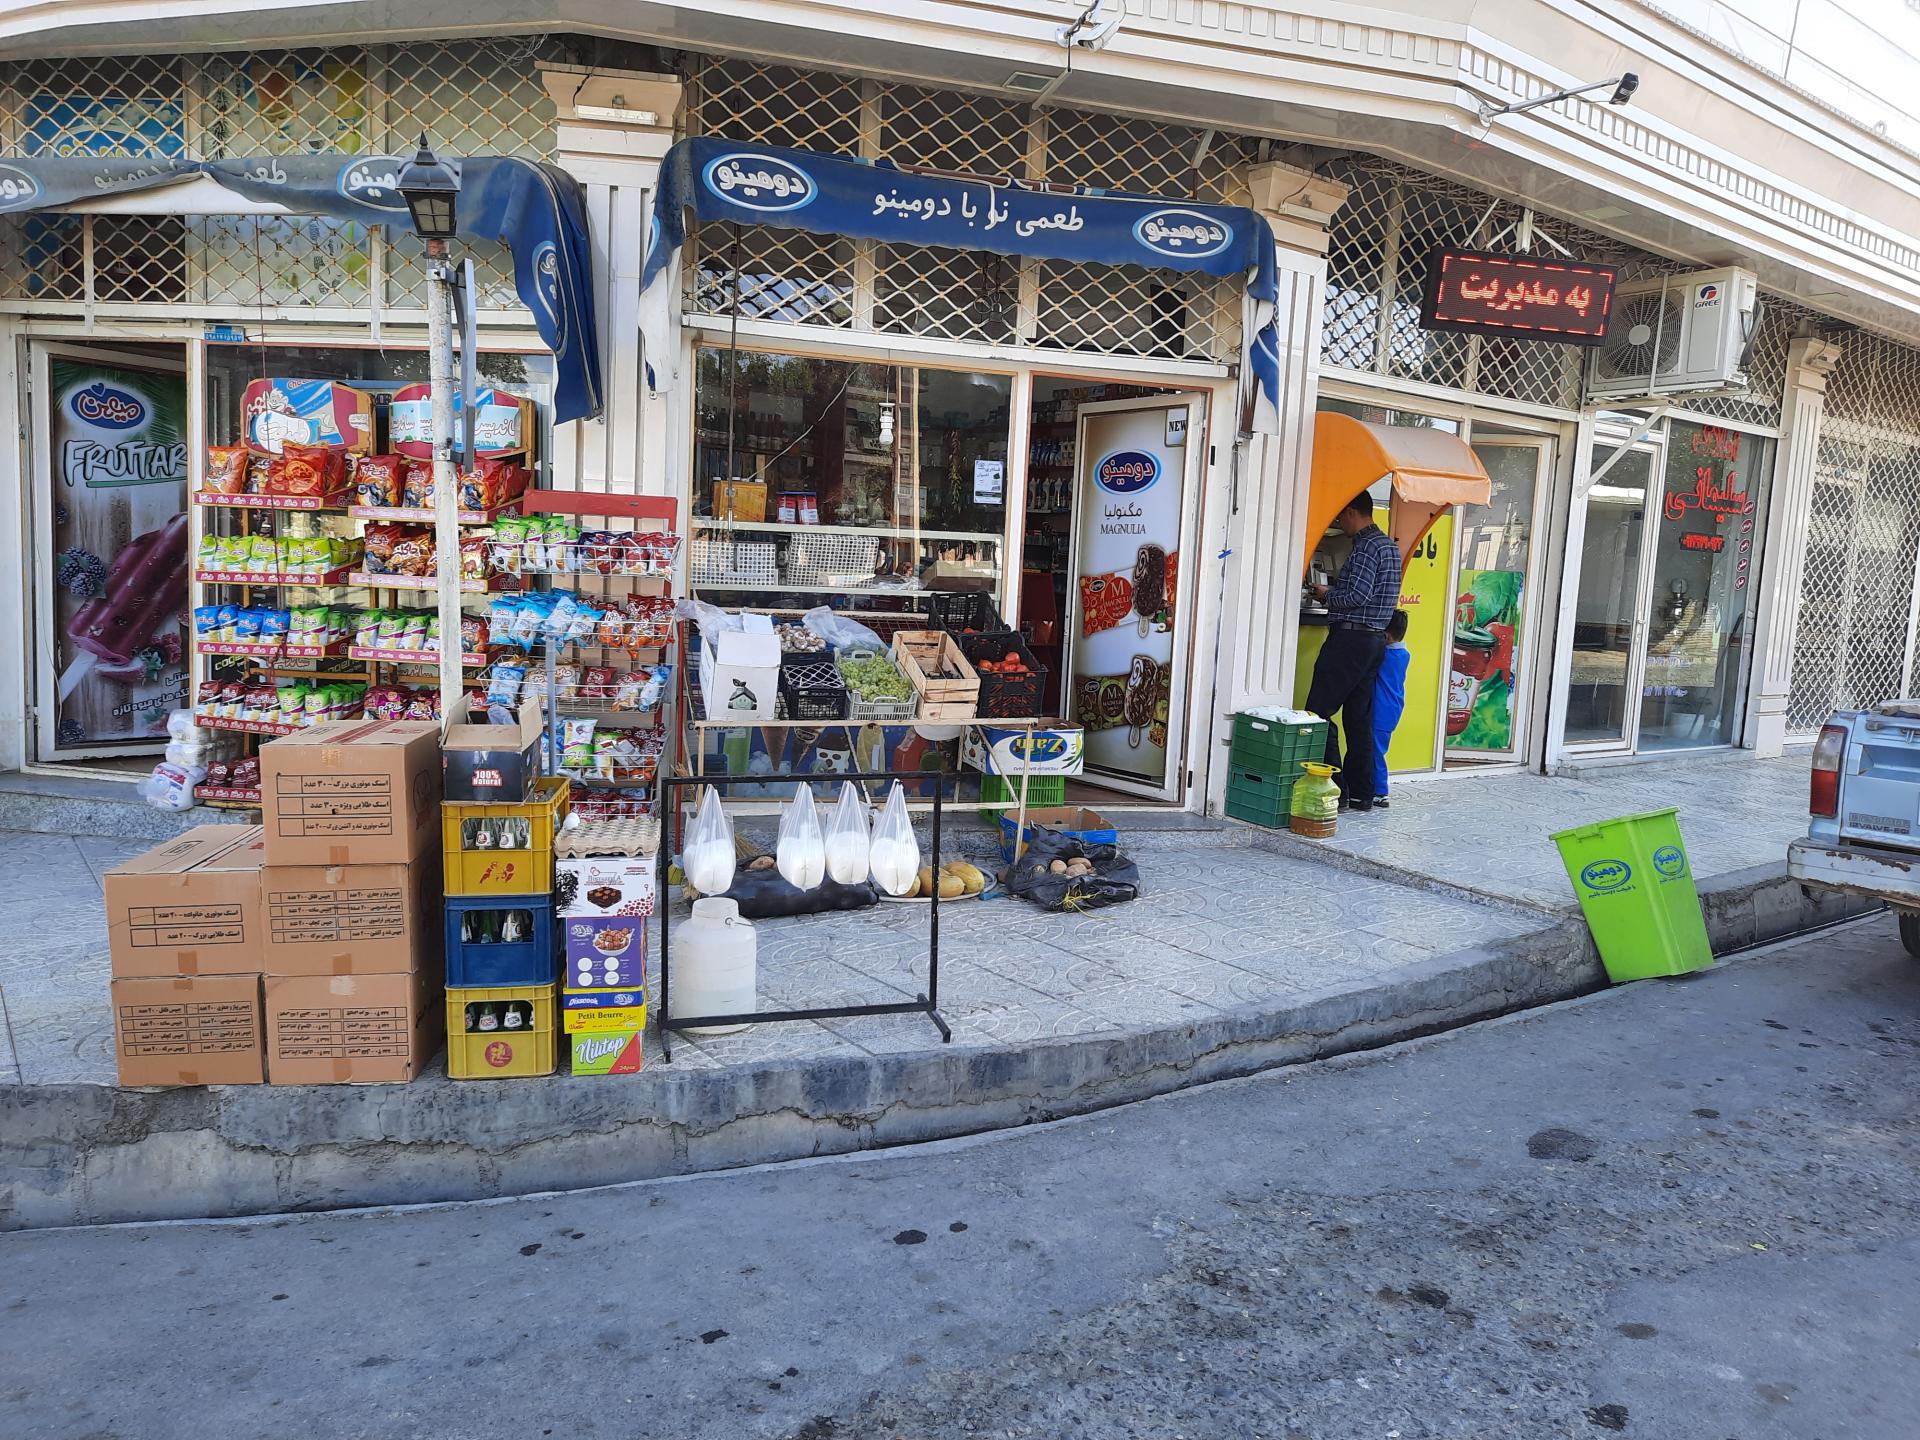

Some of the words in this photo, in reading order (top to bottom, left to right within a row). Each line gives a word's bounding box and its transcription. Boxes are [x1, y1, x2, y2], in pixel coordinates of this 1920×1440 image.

[348, 165, 397, 197] مینو
[717, 161, 805, 197] دومینو
[872, 189, 951, 220] دومینو
[961, 191, 977, 227] با
[1015, 205, 1084, 237] طعمی
[1144, 218, 1223, 246] دومینو
[1459, 272, 1559, 311] مدیریت
[1695, 299, 1720, 308] GREE
[1168, 420, 1187, 432] NEW
[1103, 459, 1154, 486] دومینو
[1104, 502, 1142, 520] مگنولیا
[1100, 524, 1146, 534] MAGNULIA
[165, 672, 190, 686] ستنی
[132, 699, 153, 711] میوه
[154, 693, 174, 707] های
[112, 703, 131, 716] تازه
[473, 778, 502, 786] Natural
[475, 770, 499, 779] 100%
[1587, 865, 1622, 880] دومینو
